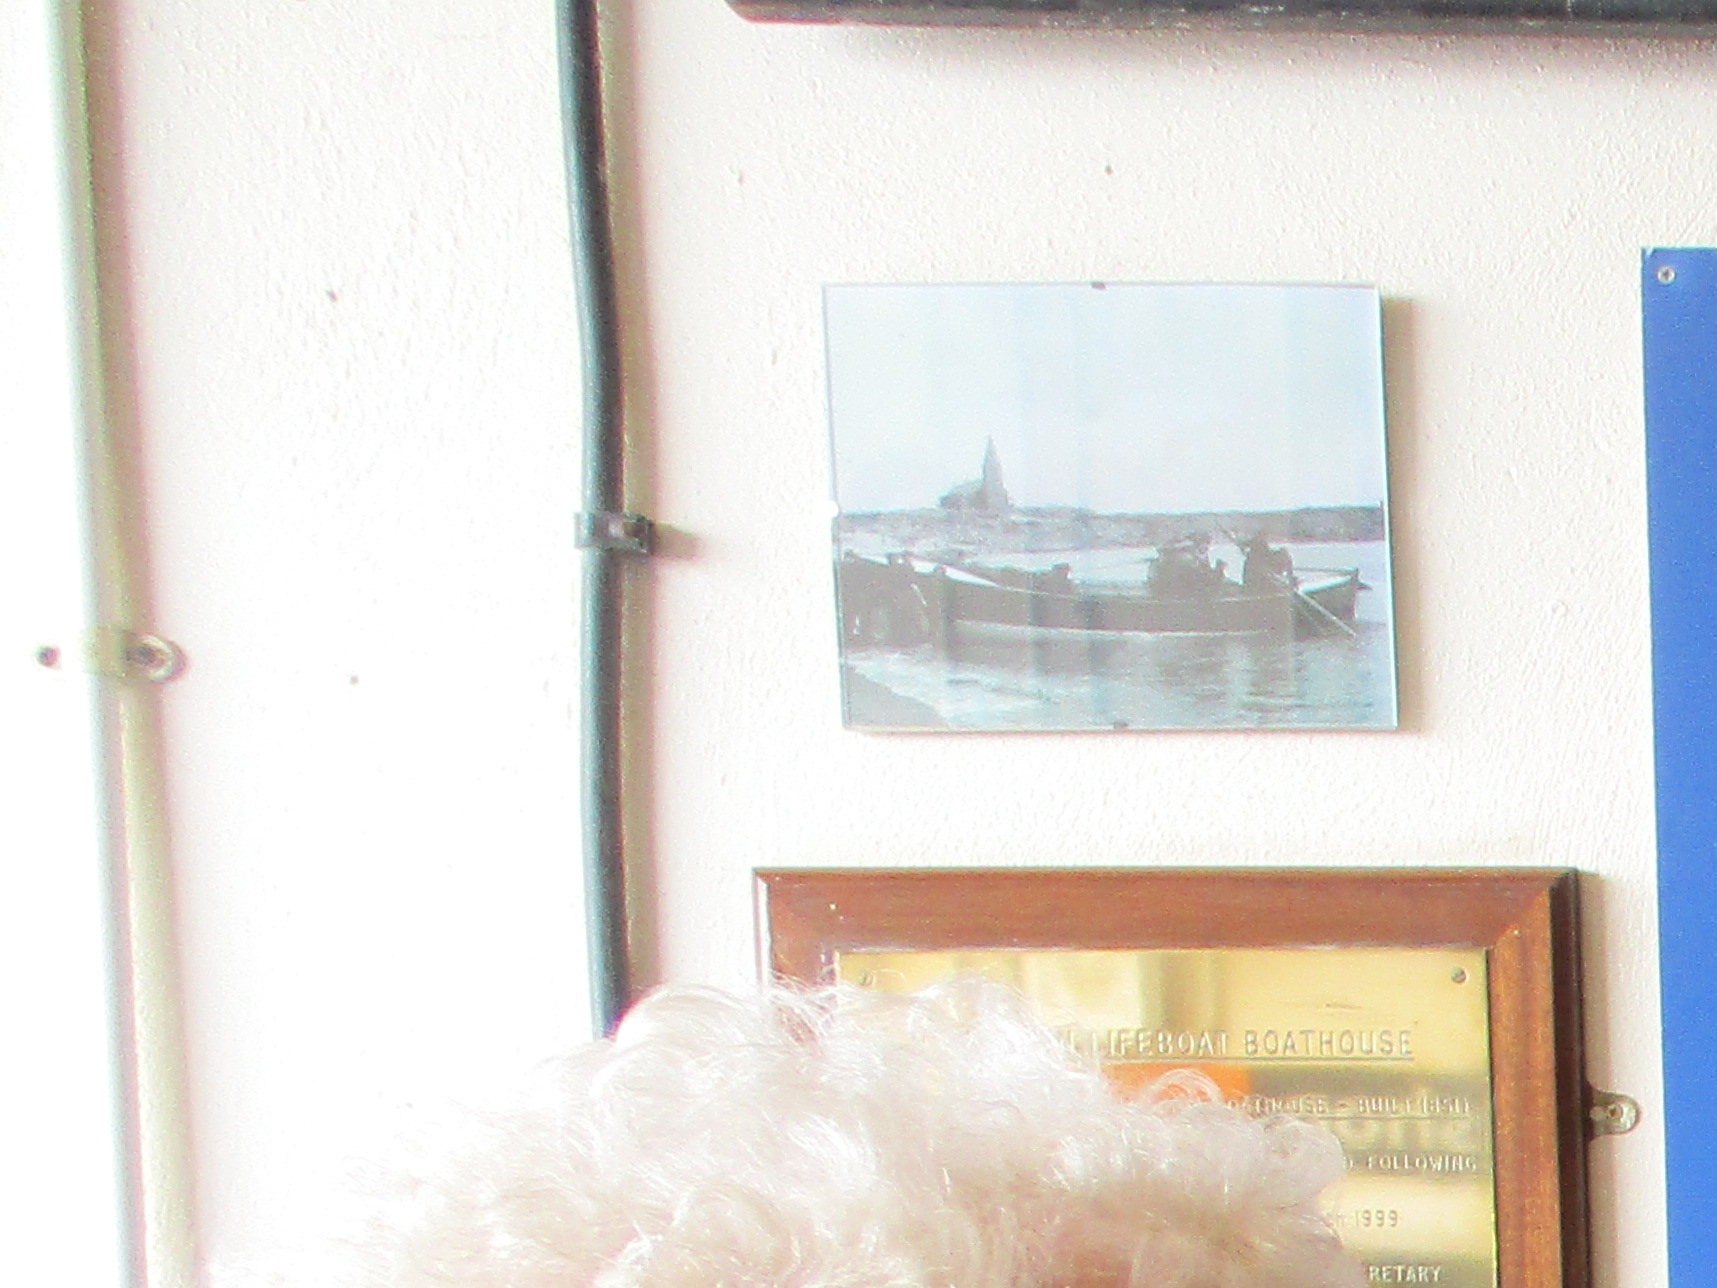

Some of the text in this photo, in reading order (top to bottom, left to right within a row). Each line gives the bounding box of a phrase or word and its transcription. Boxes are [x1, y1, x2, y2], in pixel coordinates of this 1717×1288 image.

[1243, 1029, 1414, 1057] BOATHOUSE
[1367, 1153, 1477, 1172] FOLLOWING
[1355, 1208, 1399, 1229] 1999
